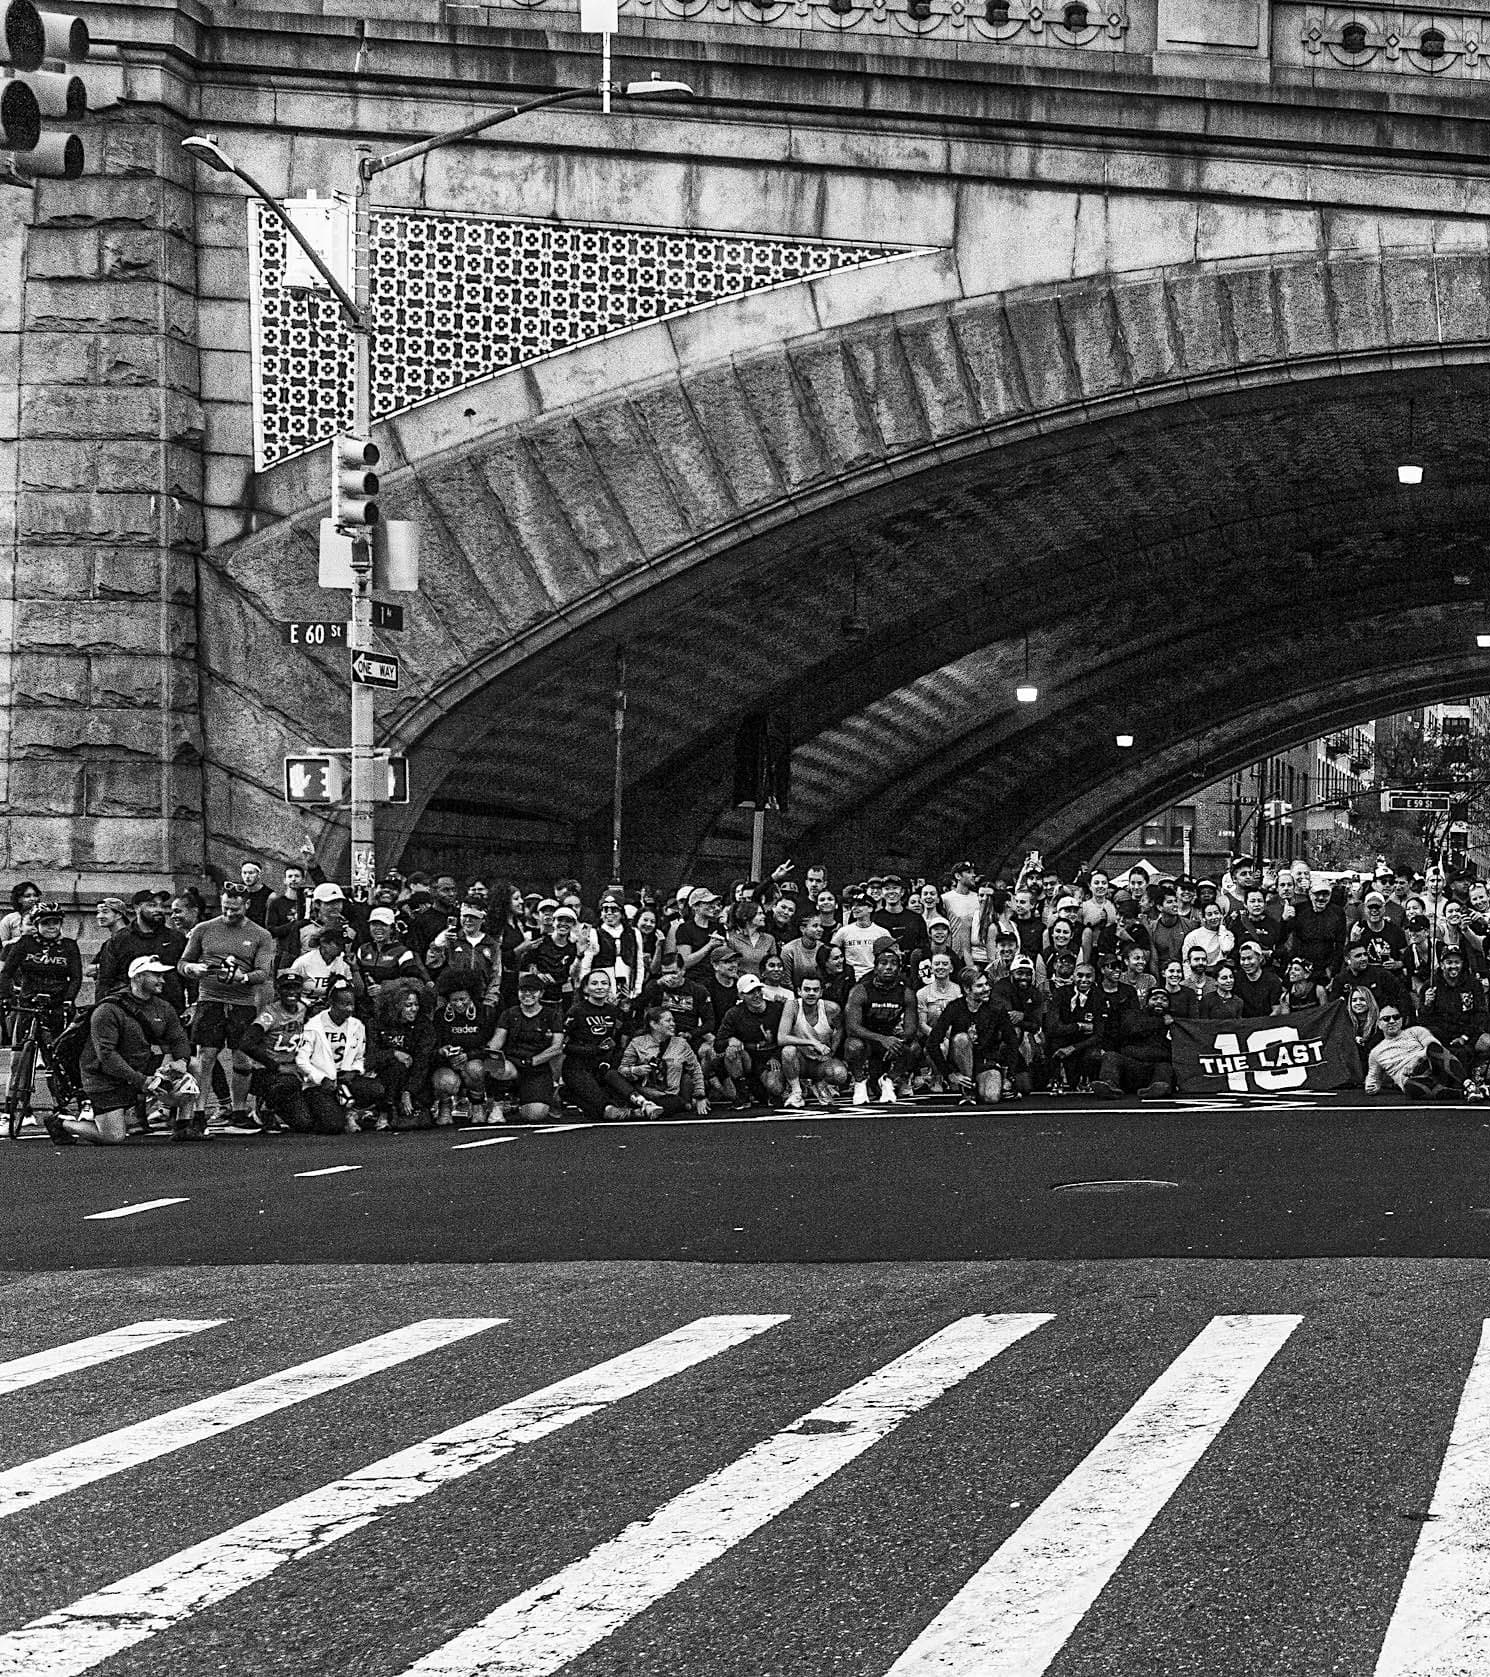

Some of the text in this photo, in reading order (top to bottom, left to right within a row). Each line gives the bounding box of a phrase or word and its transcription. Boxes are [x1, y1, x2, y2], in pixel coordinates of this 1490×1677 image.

[290, 624, 341, 644] E 60 St
[358, 660, 394, 680] ONE WAY
[1406, 799, 1412, 808] E
[1414, 799, 1424, 808] 59
[325, 1032, 347, 1043] TEA
[1200, 1041, 1323, 1074] THE LAST
